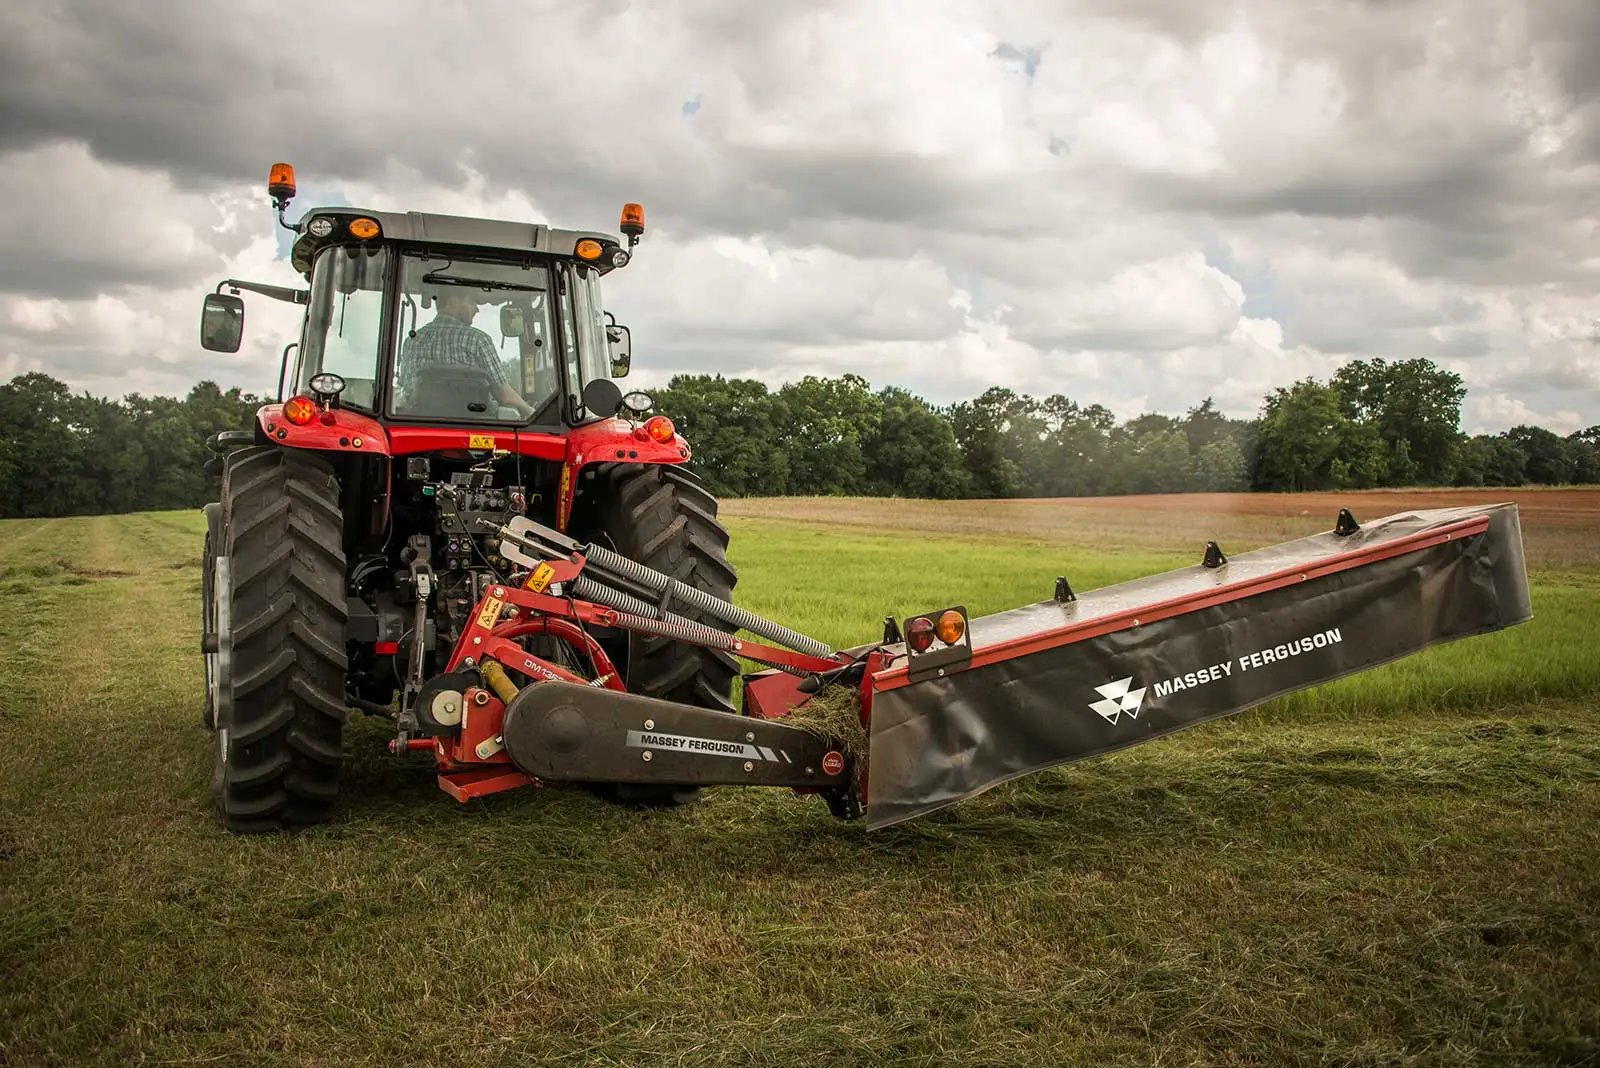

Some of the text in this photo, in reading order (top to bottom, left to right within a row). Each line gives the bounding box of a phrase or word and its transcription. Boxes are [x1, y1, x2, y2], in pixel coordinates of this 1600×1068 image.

[1153, 628, 1342, 697] MASSEY FERGUSON
[641, 734, 744, 754] MASSEY FERGUSON
